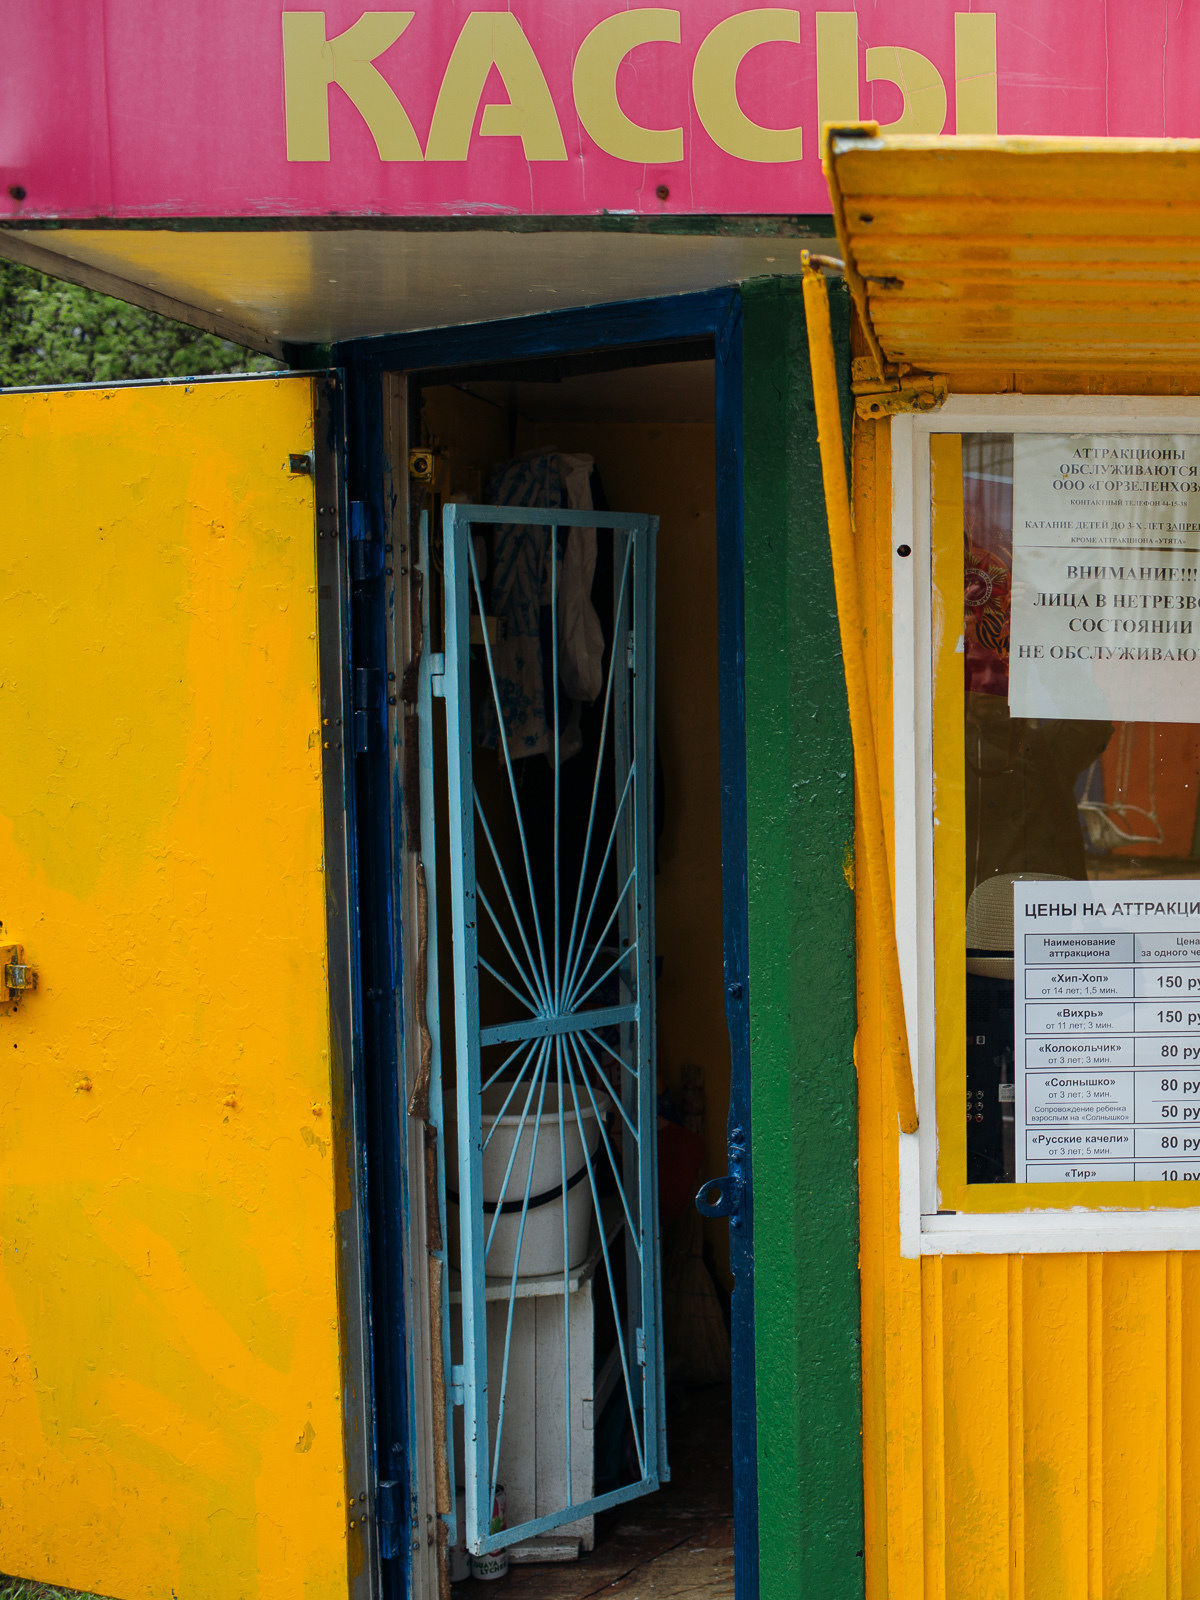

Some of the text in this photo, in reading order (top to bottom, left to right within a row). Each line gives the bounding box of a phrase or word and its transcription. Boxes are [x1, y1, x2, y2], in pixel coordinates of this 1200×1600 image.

[283, 8, 995, 163] КАССЫ
[1072, 448, 1186, 460] АТТРАКЦИОНЫ
[1059, 464, 1198, 476] ОБСЛУЖИВАЮТСЯ
[1052, 480, 1085, 490] ООО
[1025, 520, 1074, 529] КАТАНИЕ
[1076, 520, 1109, 530] ДЕТЕЙ
[1111, 522, 1125, 530] ДО
[1127, 522, 1142, 530] 3-Х
[1144, 522, 1164, 530] ЛЕТ
[1066, 565, 1197, 581] ВНИМАНИЕ!!!
[1033, 593, 1089, 609] ЛИЦА
[1095, 594, 1106, 607] В
[1069, 618, 1192, 634] СОСТОЯНИИ
[1018, 645, 1044, 658] НЕ
[1025, 903, 1076, 919] ЦЕНЫ
[1083, 903, 1106, 916] НА
[1044, 936, 1115, 947] Наименование
[1176, 937, 1200, 947] Цена
[1049, 949, 1110, 958] аттракциона
[1154, 949, 1188, 958] одного
[1051, 974, 1108, 982] «Хип-Хоп»
[1157, 976, 1182, 988] 150
[1085, 986, 1097, 995] 1,5
[1057, 1009, 1103, 1019] «Вихрь»
[1158, 1010, 1182, 1022] 150
[1088, 1021, 1093, 1029] 3
[1096, 1020, 1114, 1028] мин.
[1039, 1044, 1121, 1052] «Колокольчик»
[1161, 1045, 1178, 1057] 80
[1060, 1056, 1066, 1064] 3
[1068, 1057, 1084, 1065] лет;
[1094, 1056, 1112, 1064] мин.
[1045, 1078, 1115, 1087] «Солнышко»
[1161, 1079, 1178, 1091] 80
[1060, 1090, 1066, 1098] 3
[1086, 1090, 1091, 1098] 3
[1162, 1105, 1178, 1118] 50
[1032, 1135, 1082, 1145] «Русские
[1161, 1136, 1178, 1148] 80
[1060, 1148, 1066, 1156] 3
[1065, 1169, 1096, 1178] «Тир»
[1162, 1170, 1178, 1180] 10
